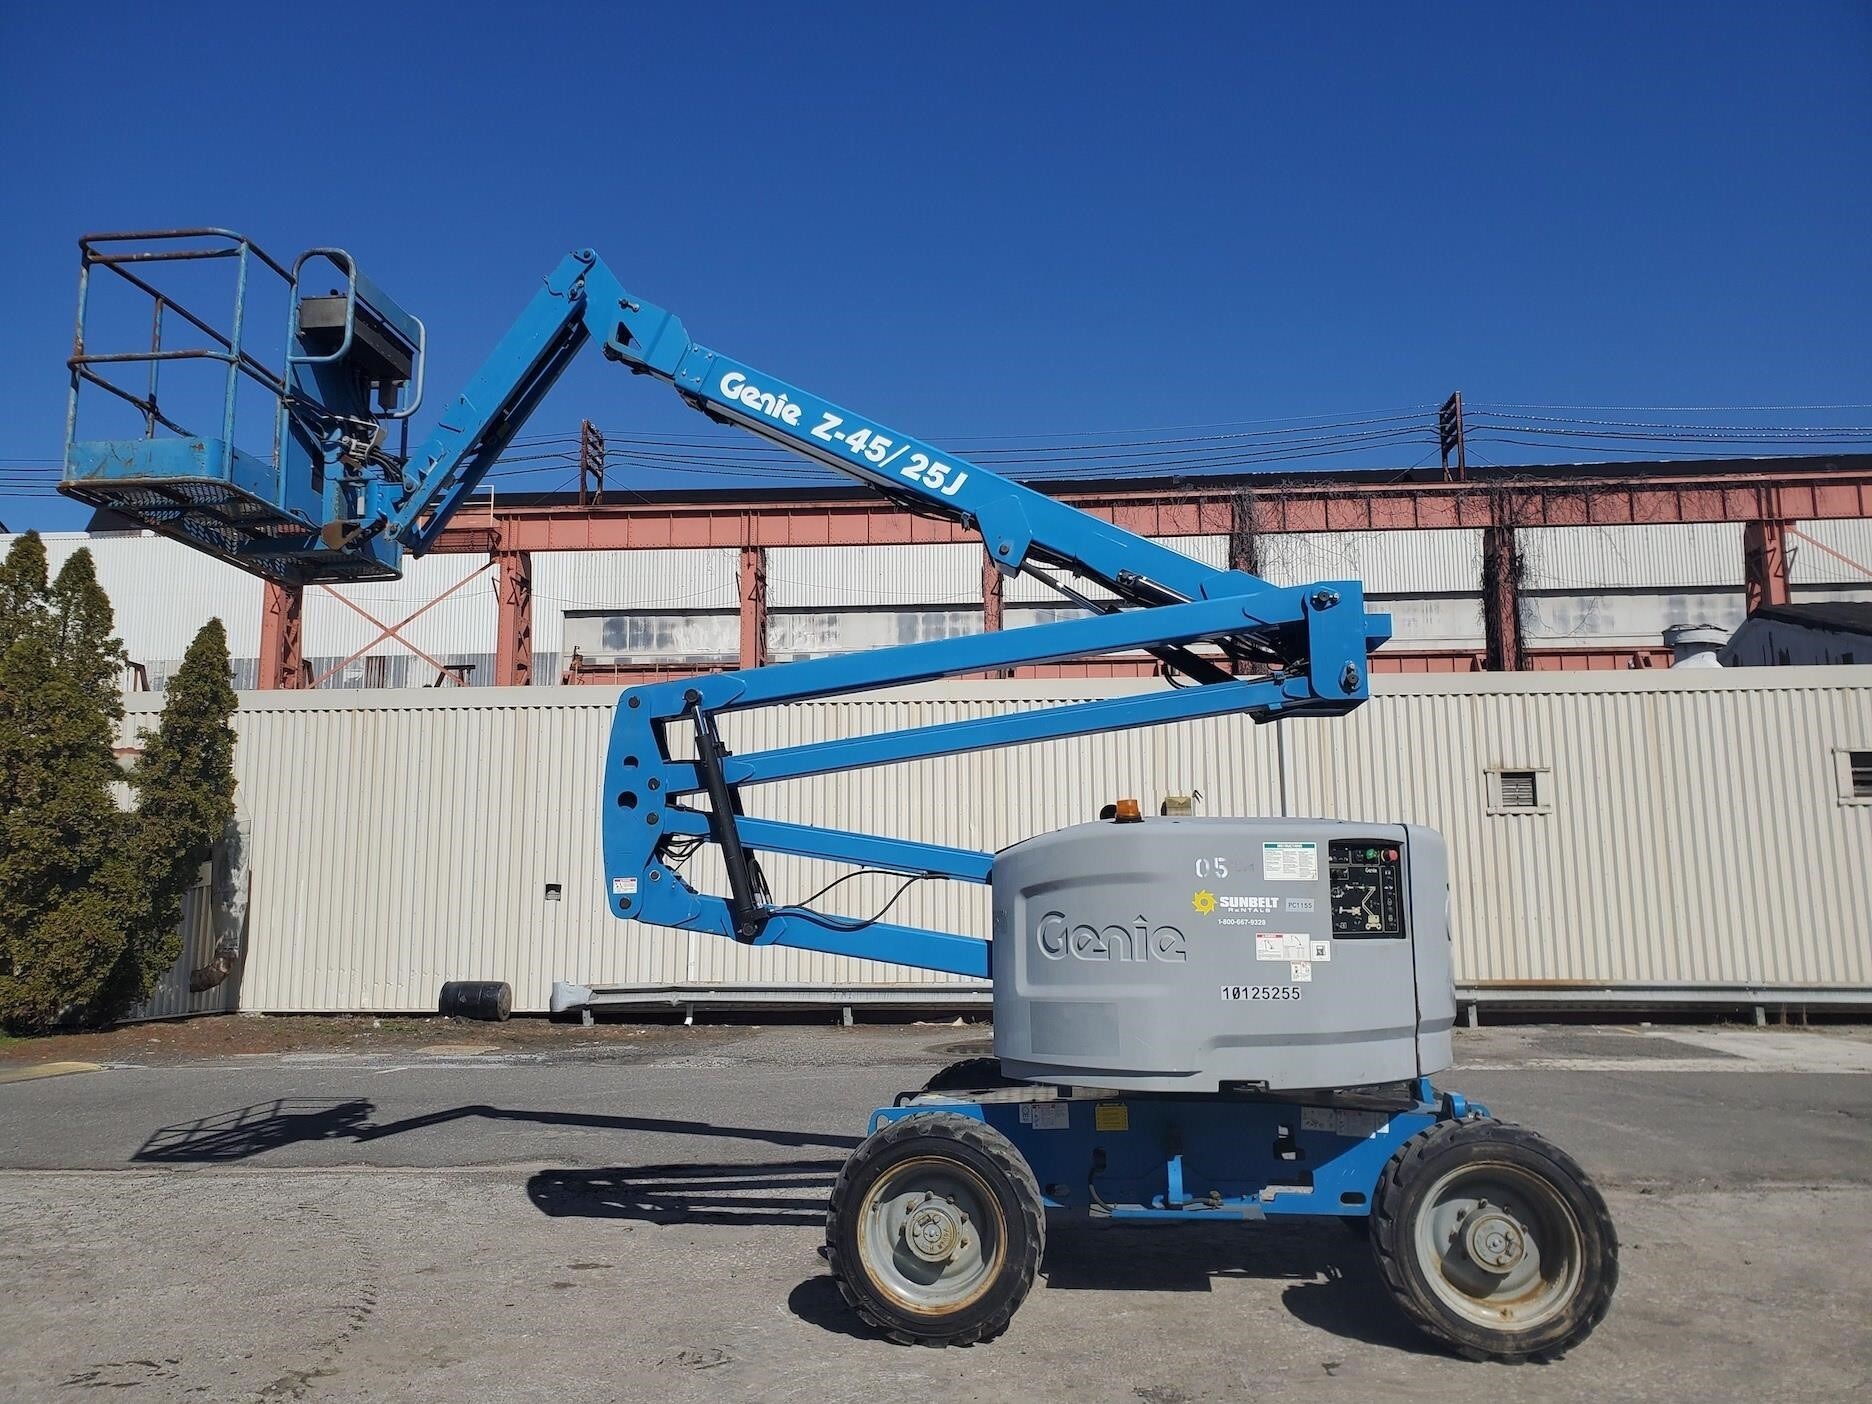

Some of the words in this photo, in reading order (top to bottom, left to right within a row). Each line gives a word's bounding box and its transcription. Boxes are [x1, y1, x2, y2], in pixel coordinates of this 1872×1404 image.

[720, 371, 802, 427] Genie
[811, 411, 968, 496] Z-45/25J
[1195, 857, 1229, 879] 05
[1219, 896, 1279, 908] SUNBELT
[1217, 918, 1266, 926] 1-800-667-9328
[1036, 911, 1187, 963] Genie
[1222, 987, 1300, 1000] 10125255
